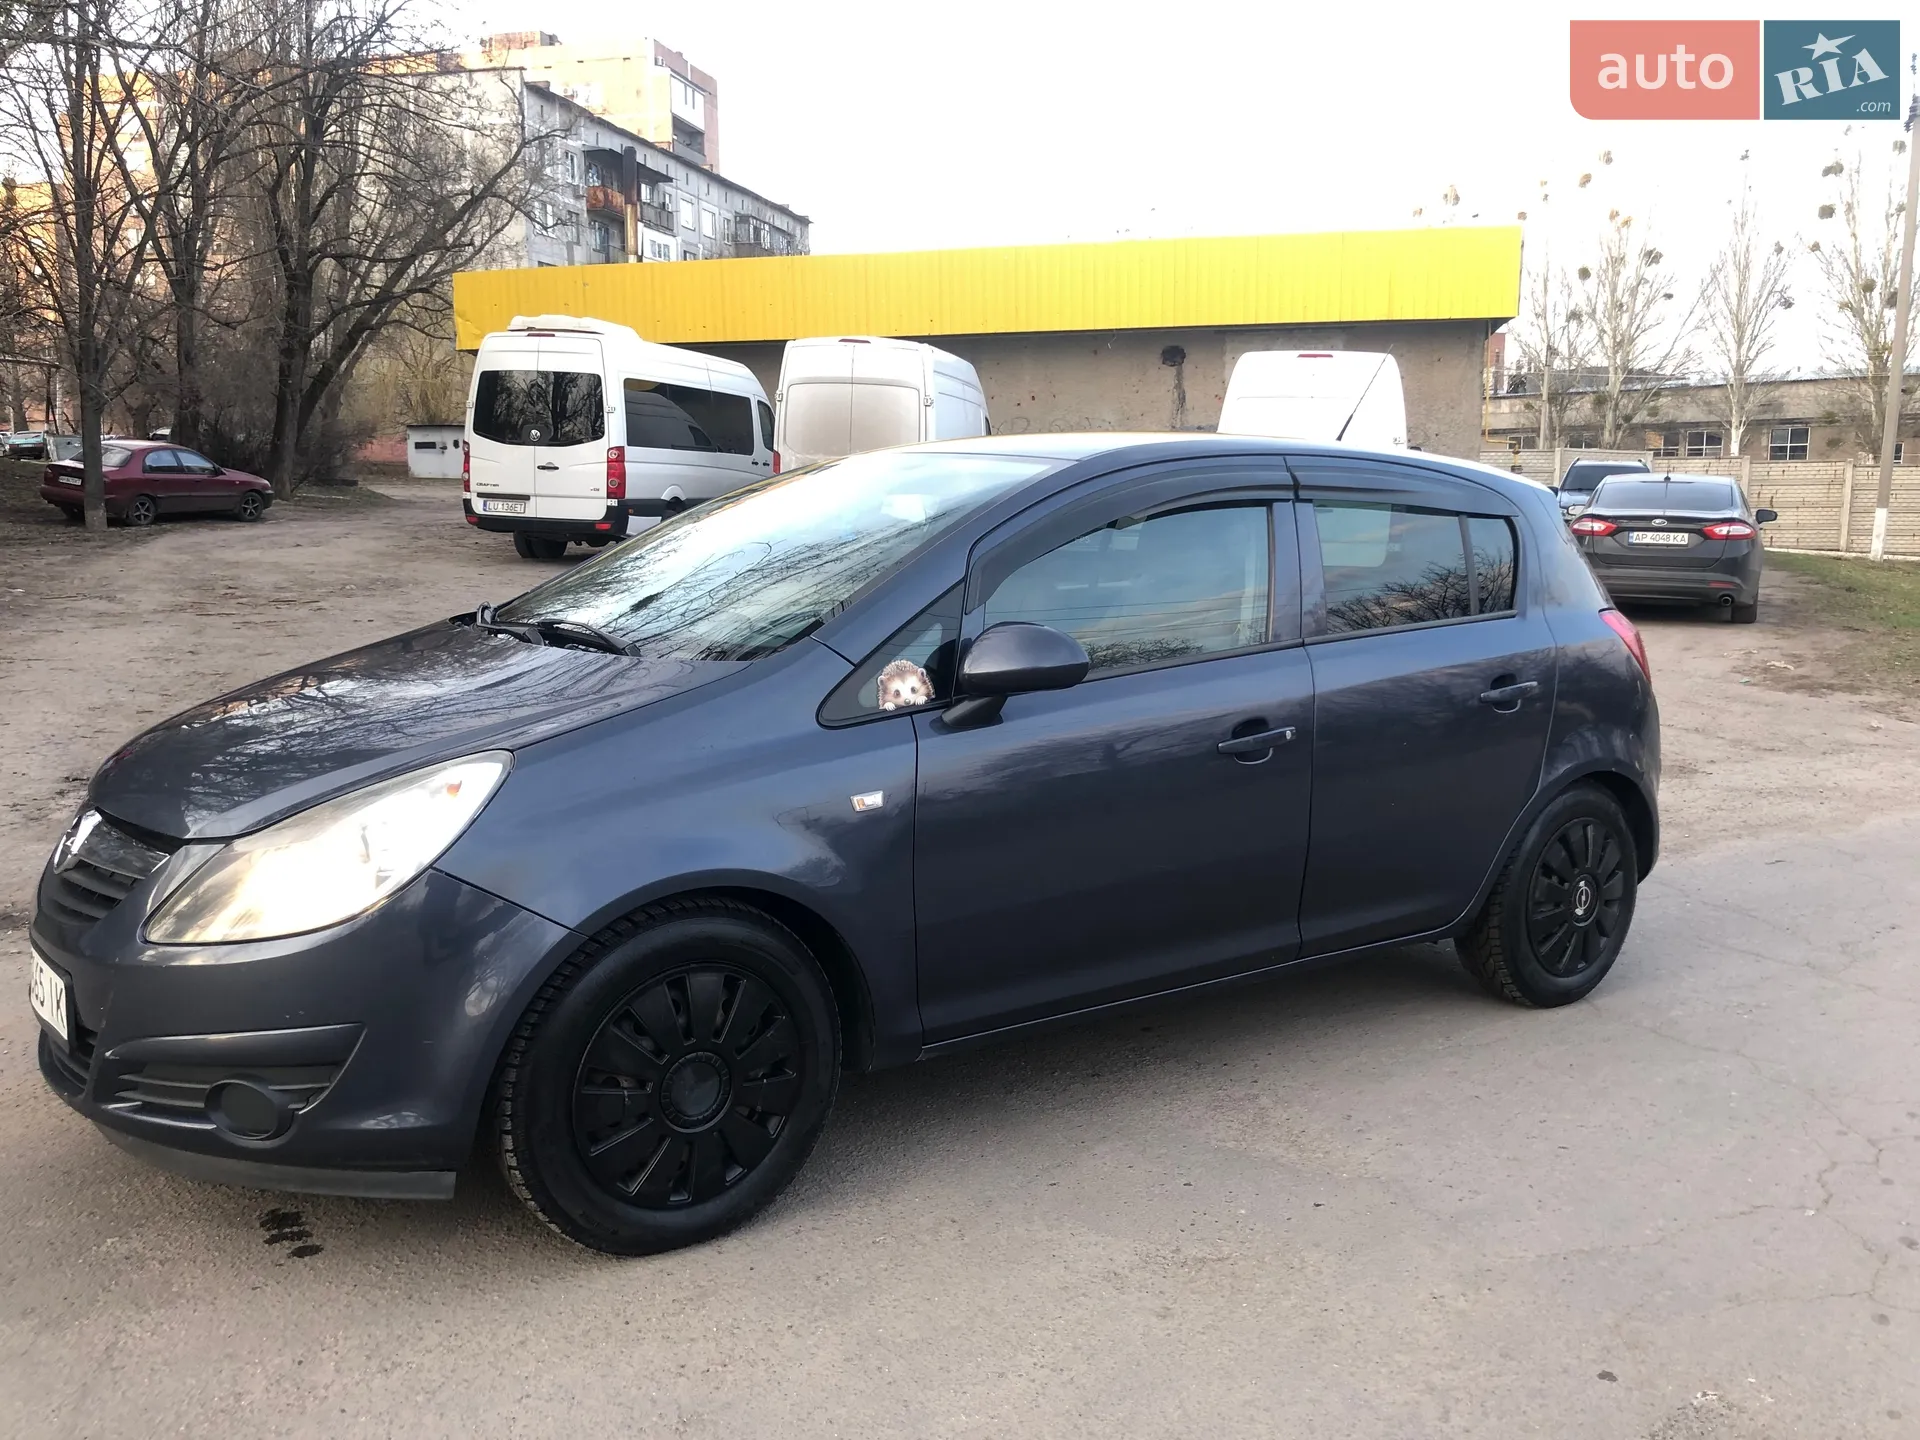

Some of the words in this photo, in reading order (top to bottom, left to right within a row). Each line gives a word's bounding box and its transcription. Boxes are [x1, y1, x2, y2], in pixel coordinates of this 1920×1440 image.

[487, 502, 499, 511] LU
[501, 503, 524, 512] 136ET
[1634, 533, 1648, 542] AP
[1649, 534, 1671, 542] 4048
[1672, 534, 1687, 543] KA
[49, 976, 66, 1030] IK
